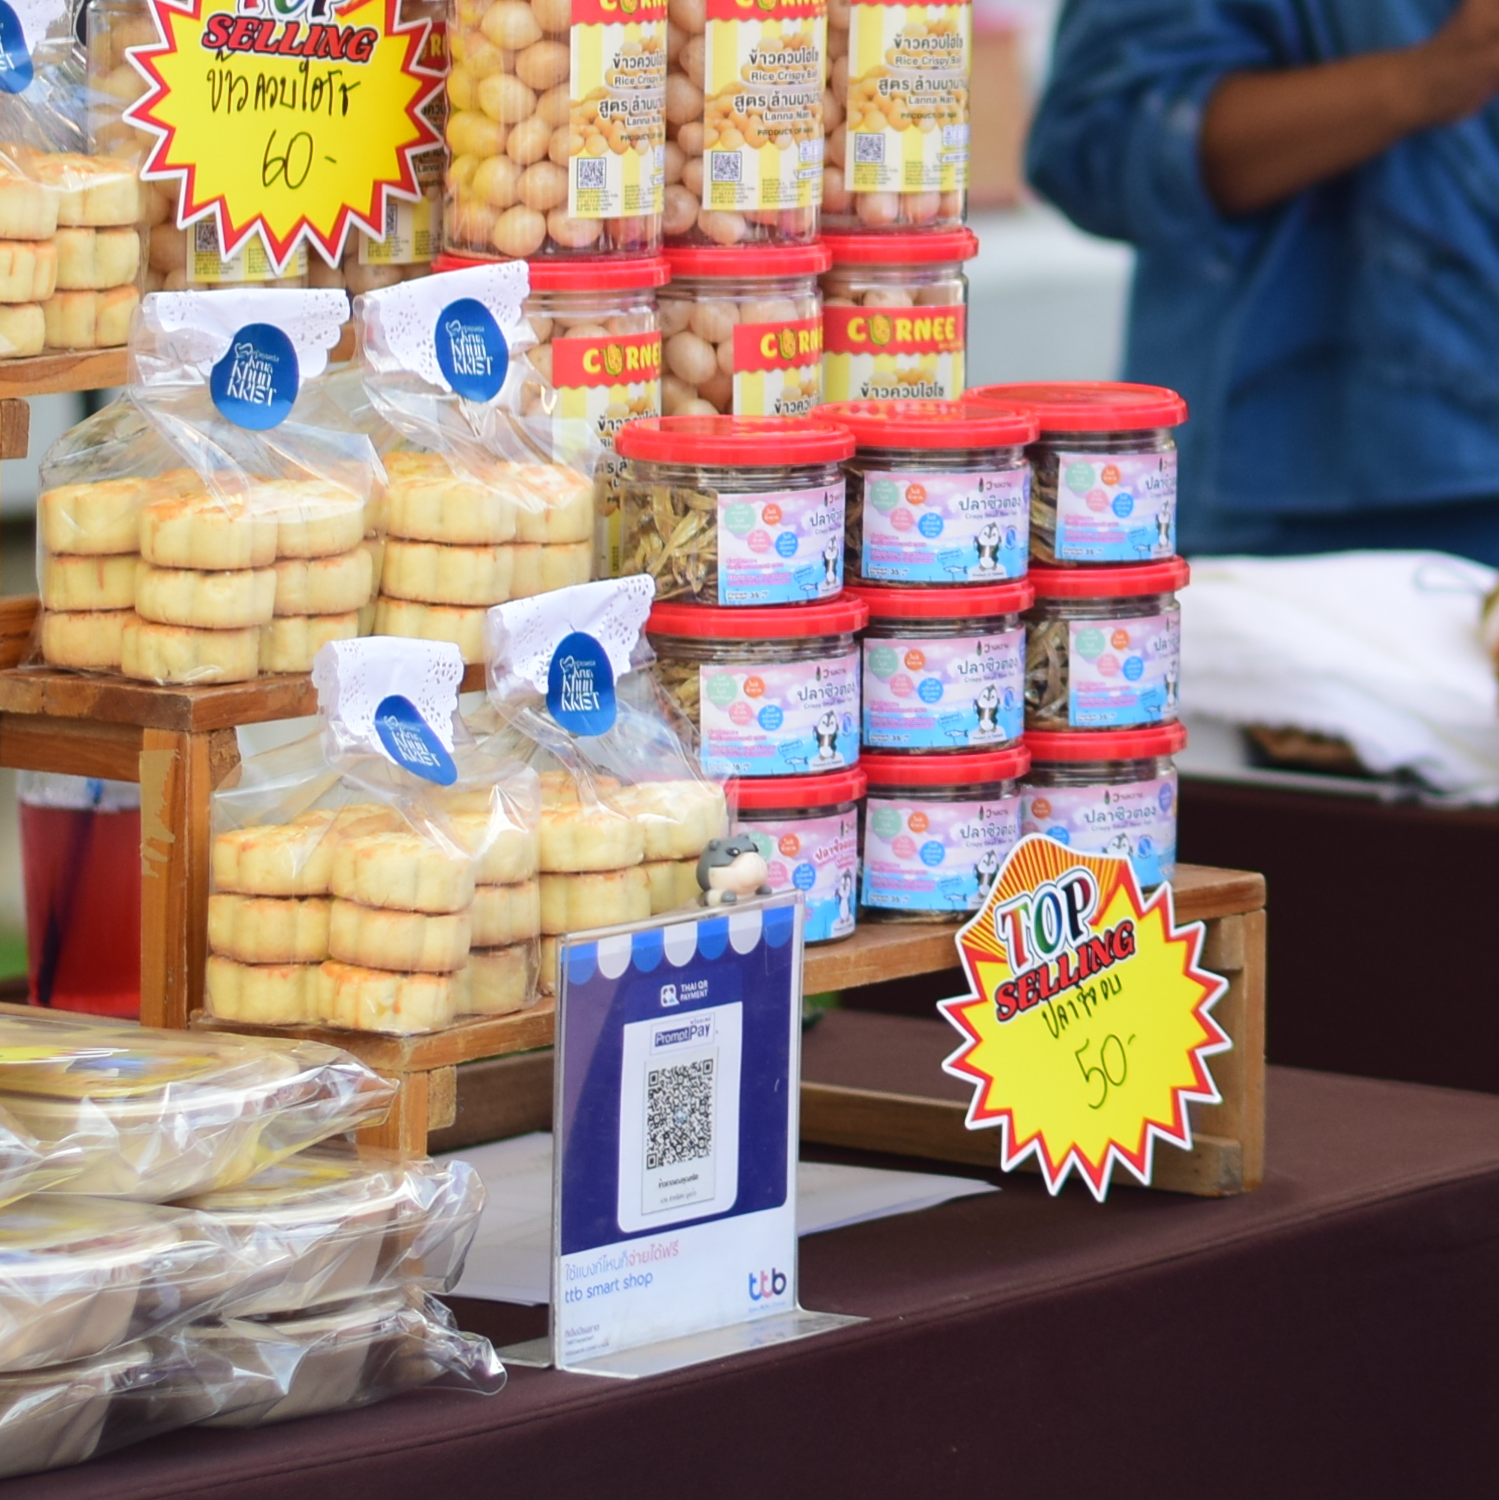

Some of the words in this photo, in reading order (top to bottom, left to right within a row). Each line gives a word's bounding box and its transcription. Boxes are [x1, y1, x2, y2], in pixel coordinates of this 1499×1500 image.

[201, 14, 379, 63] SELLING
[751, 71, 774, 81] Rice
[895, 56, 918, 66] Rice
[998, 871, 1095, 973] TOP
[680, 982, 697, 992] THAI
[698, 979, 708, 989] QR
[994, 918, 1136, 1022] SELLING
[680, 989, 708, 1002] PAYMENT
[565, 1286, 584, 1303] ttb
[586, 1278, 620, 1298] smart
[623, 1272, 653, 1289] shop
[749, 1266, 787, 1301] ttb
